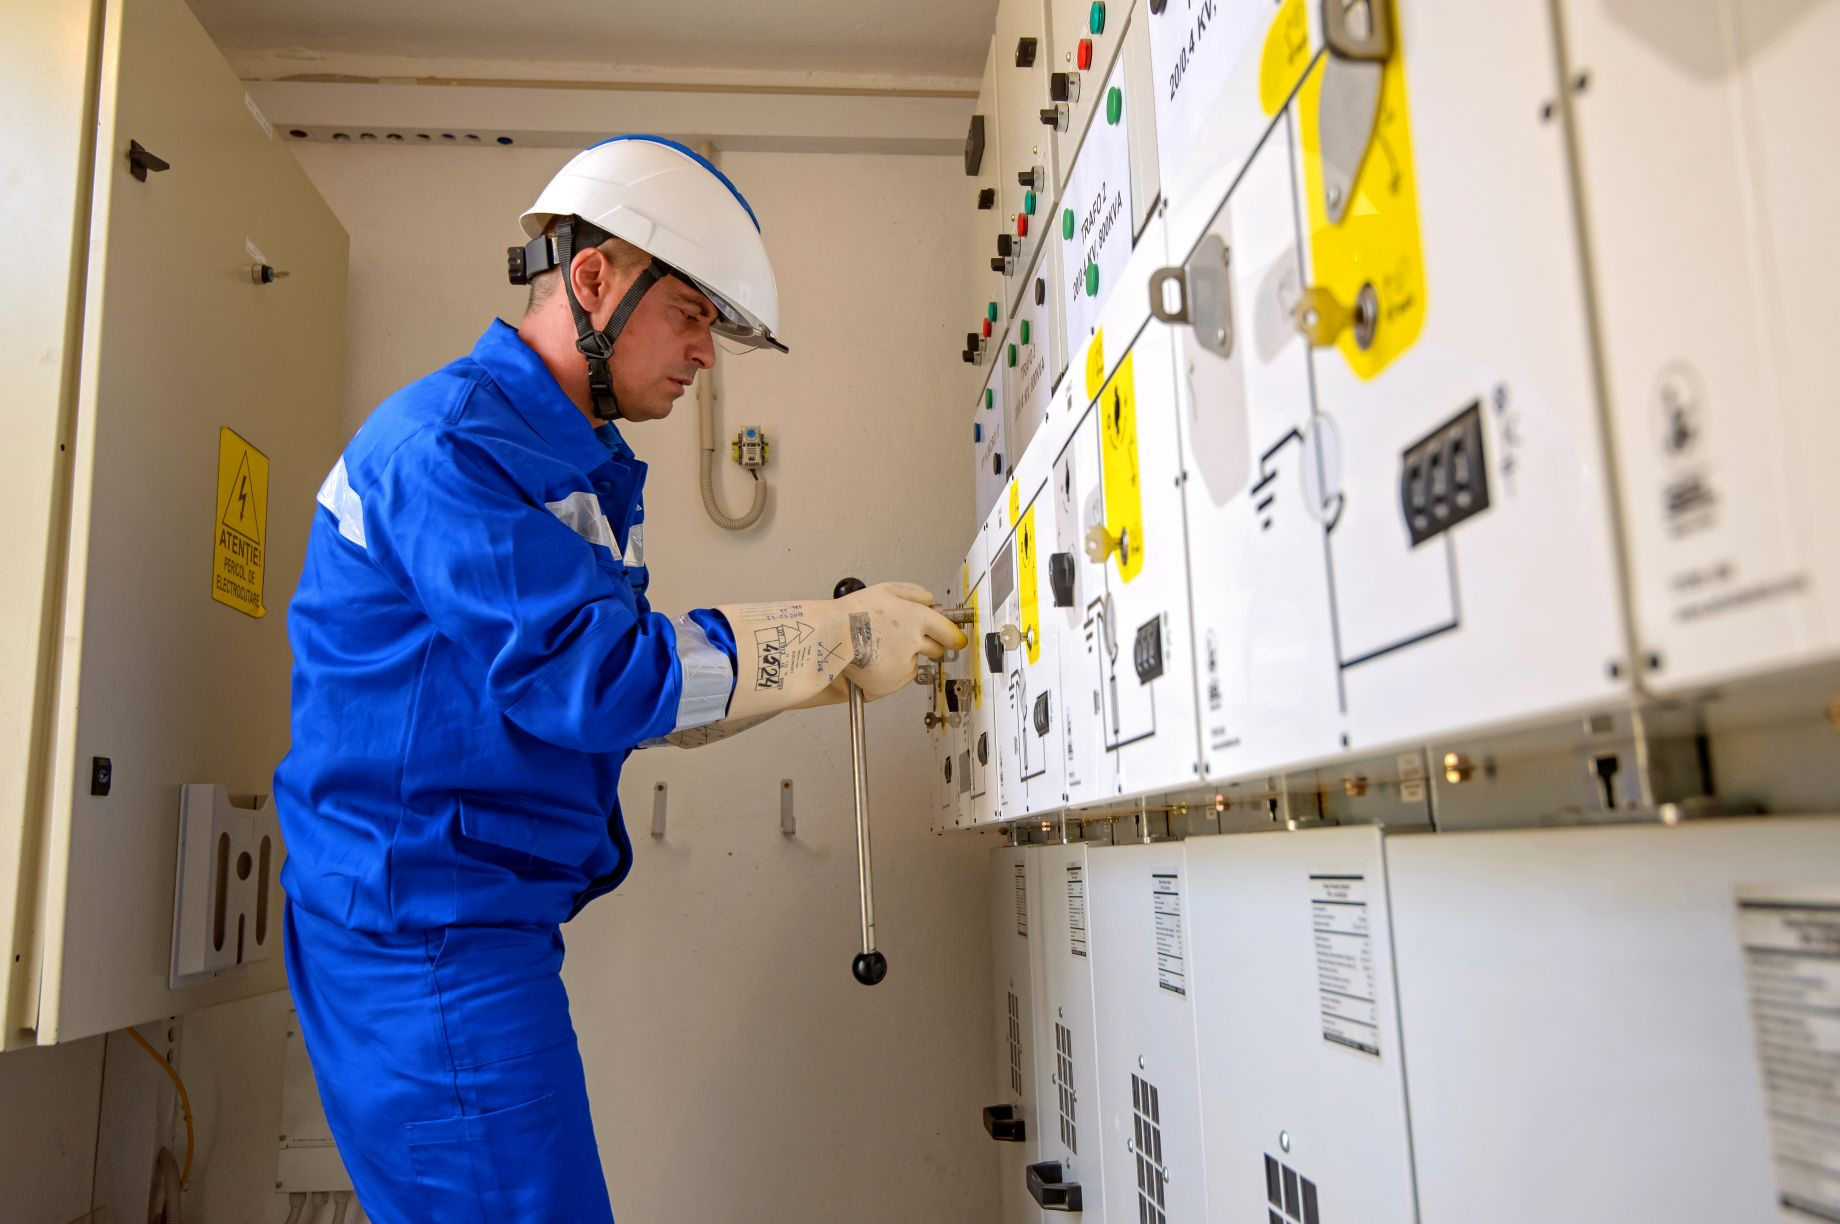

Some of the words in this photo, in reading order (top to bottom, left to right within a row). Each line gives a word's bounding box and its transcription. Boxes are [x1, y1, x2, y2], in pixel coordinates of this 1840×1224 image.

[1081, 193, 1102, 244] TRAFO
[224, 557, 246, 581] PERICOL
[248, 569, 256, 585] DE
[216, 574, 260, 608] ELECTROCUTARE
